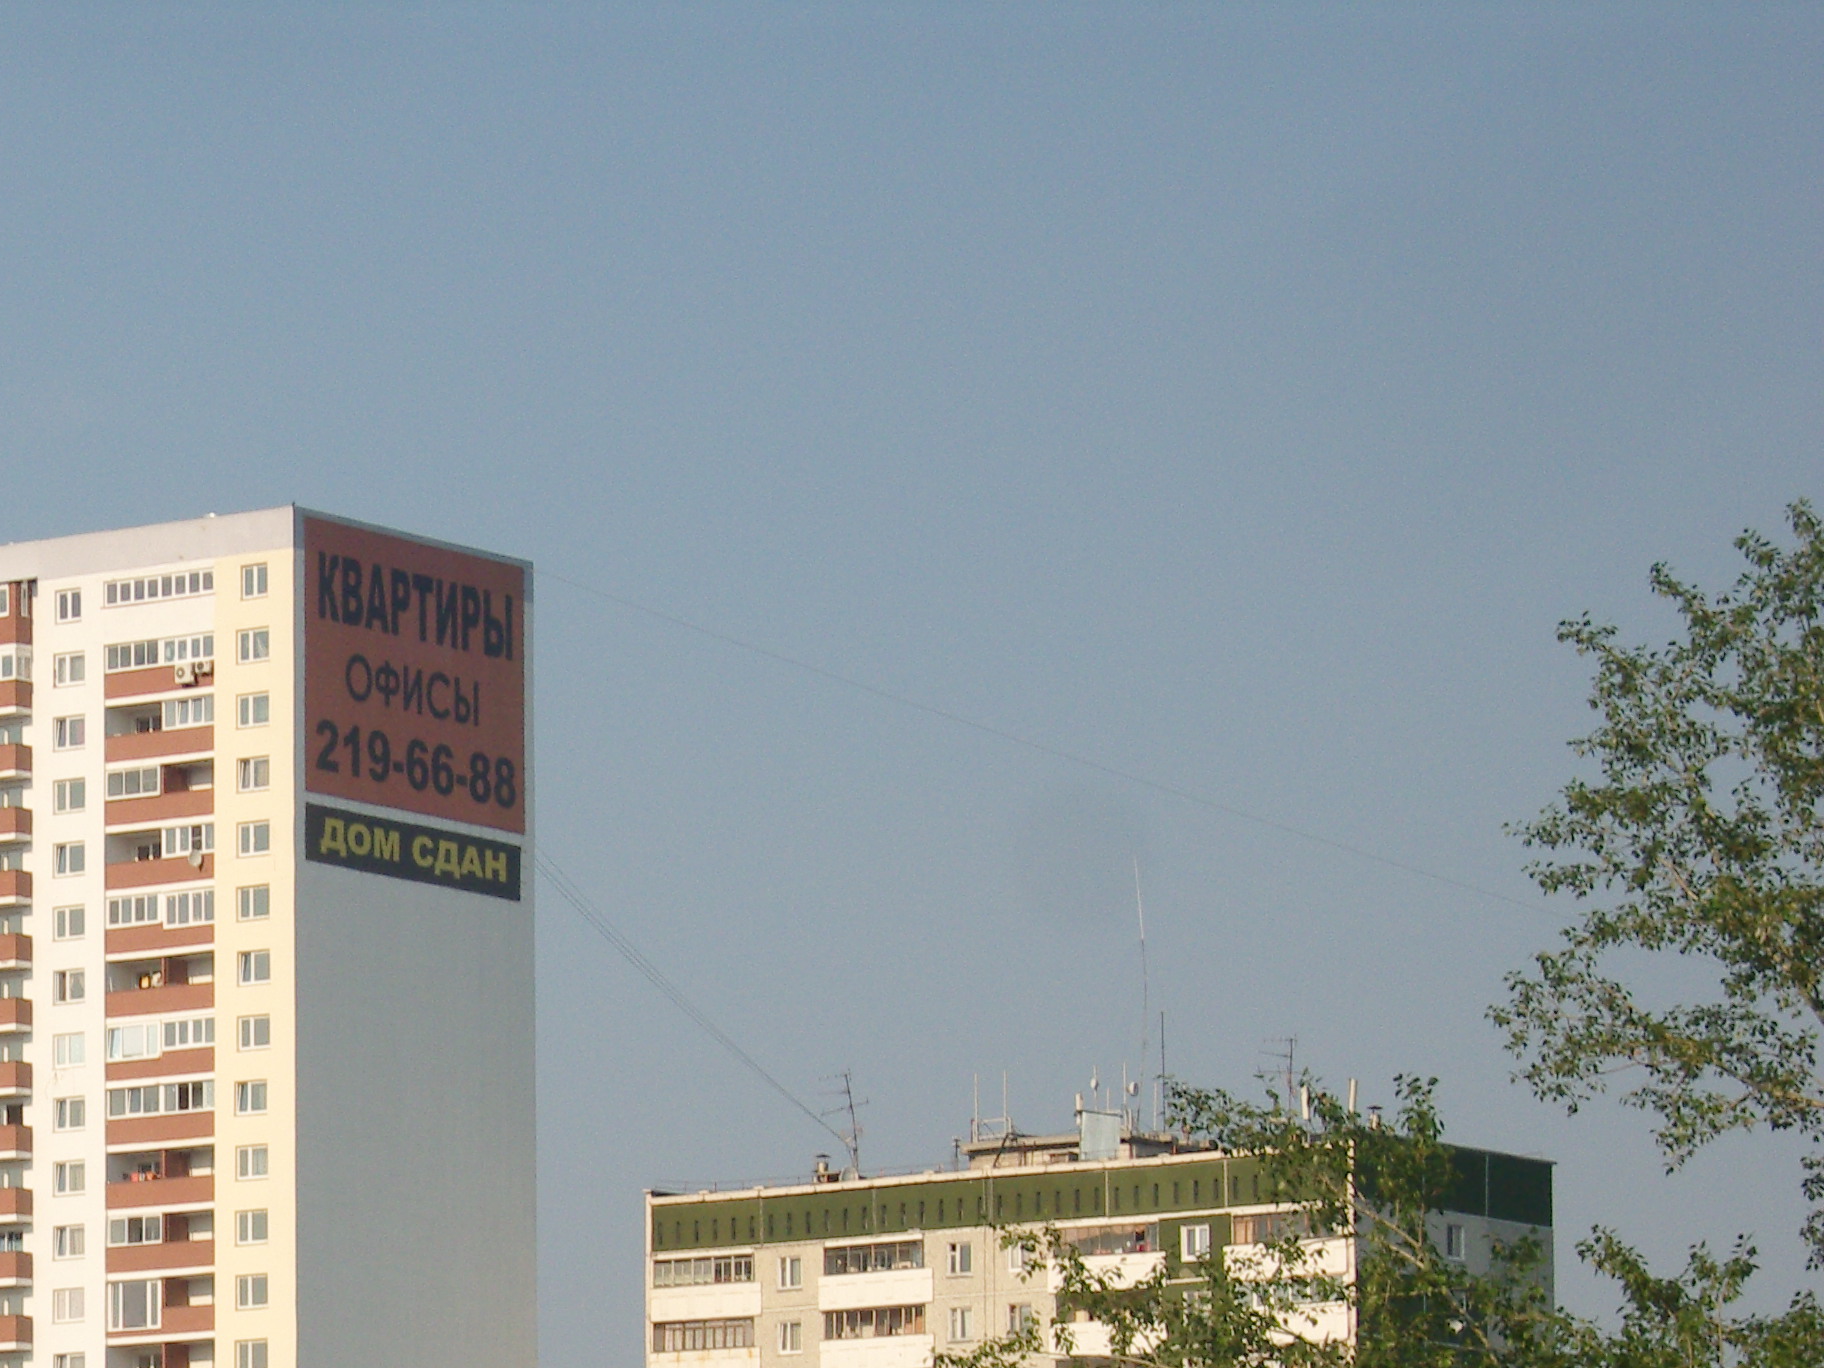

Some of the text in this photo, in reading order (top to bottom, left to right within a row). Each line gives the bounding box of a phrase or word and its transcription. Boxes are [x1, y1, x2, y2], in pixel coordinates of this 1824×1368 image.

[318, 551, 514, 661] КВАРТИРЫ
[345, 653, 480, 727] ОФИСЫ
[316, 719, 516, 809] 219-66-88
[320, 816, 507, 883] ДОМ СДАН
